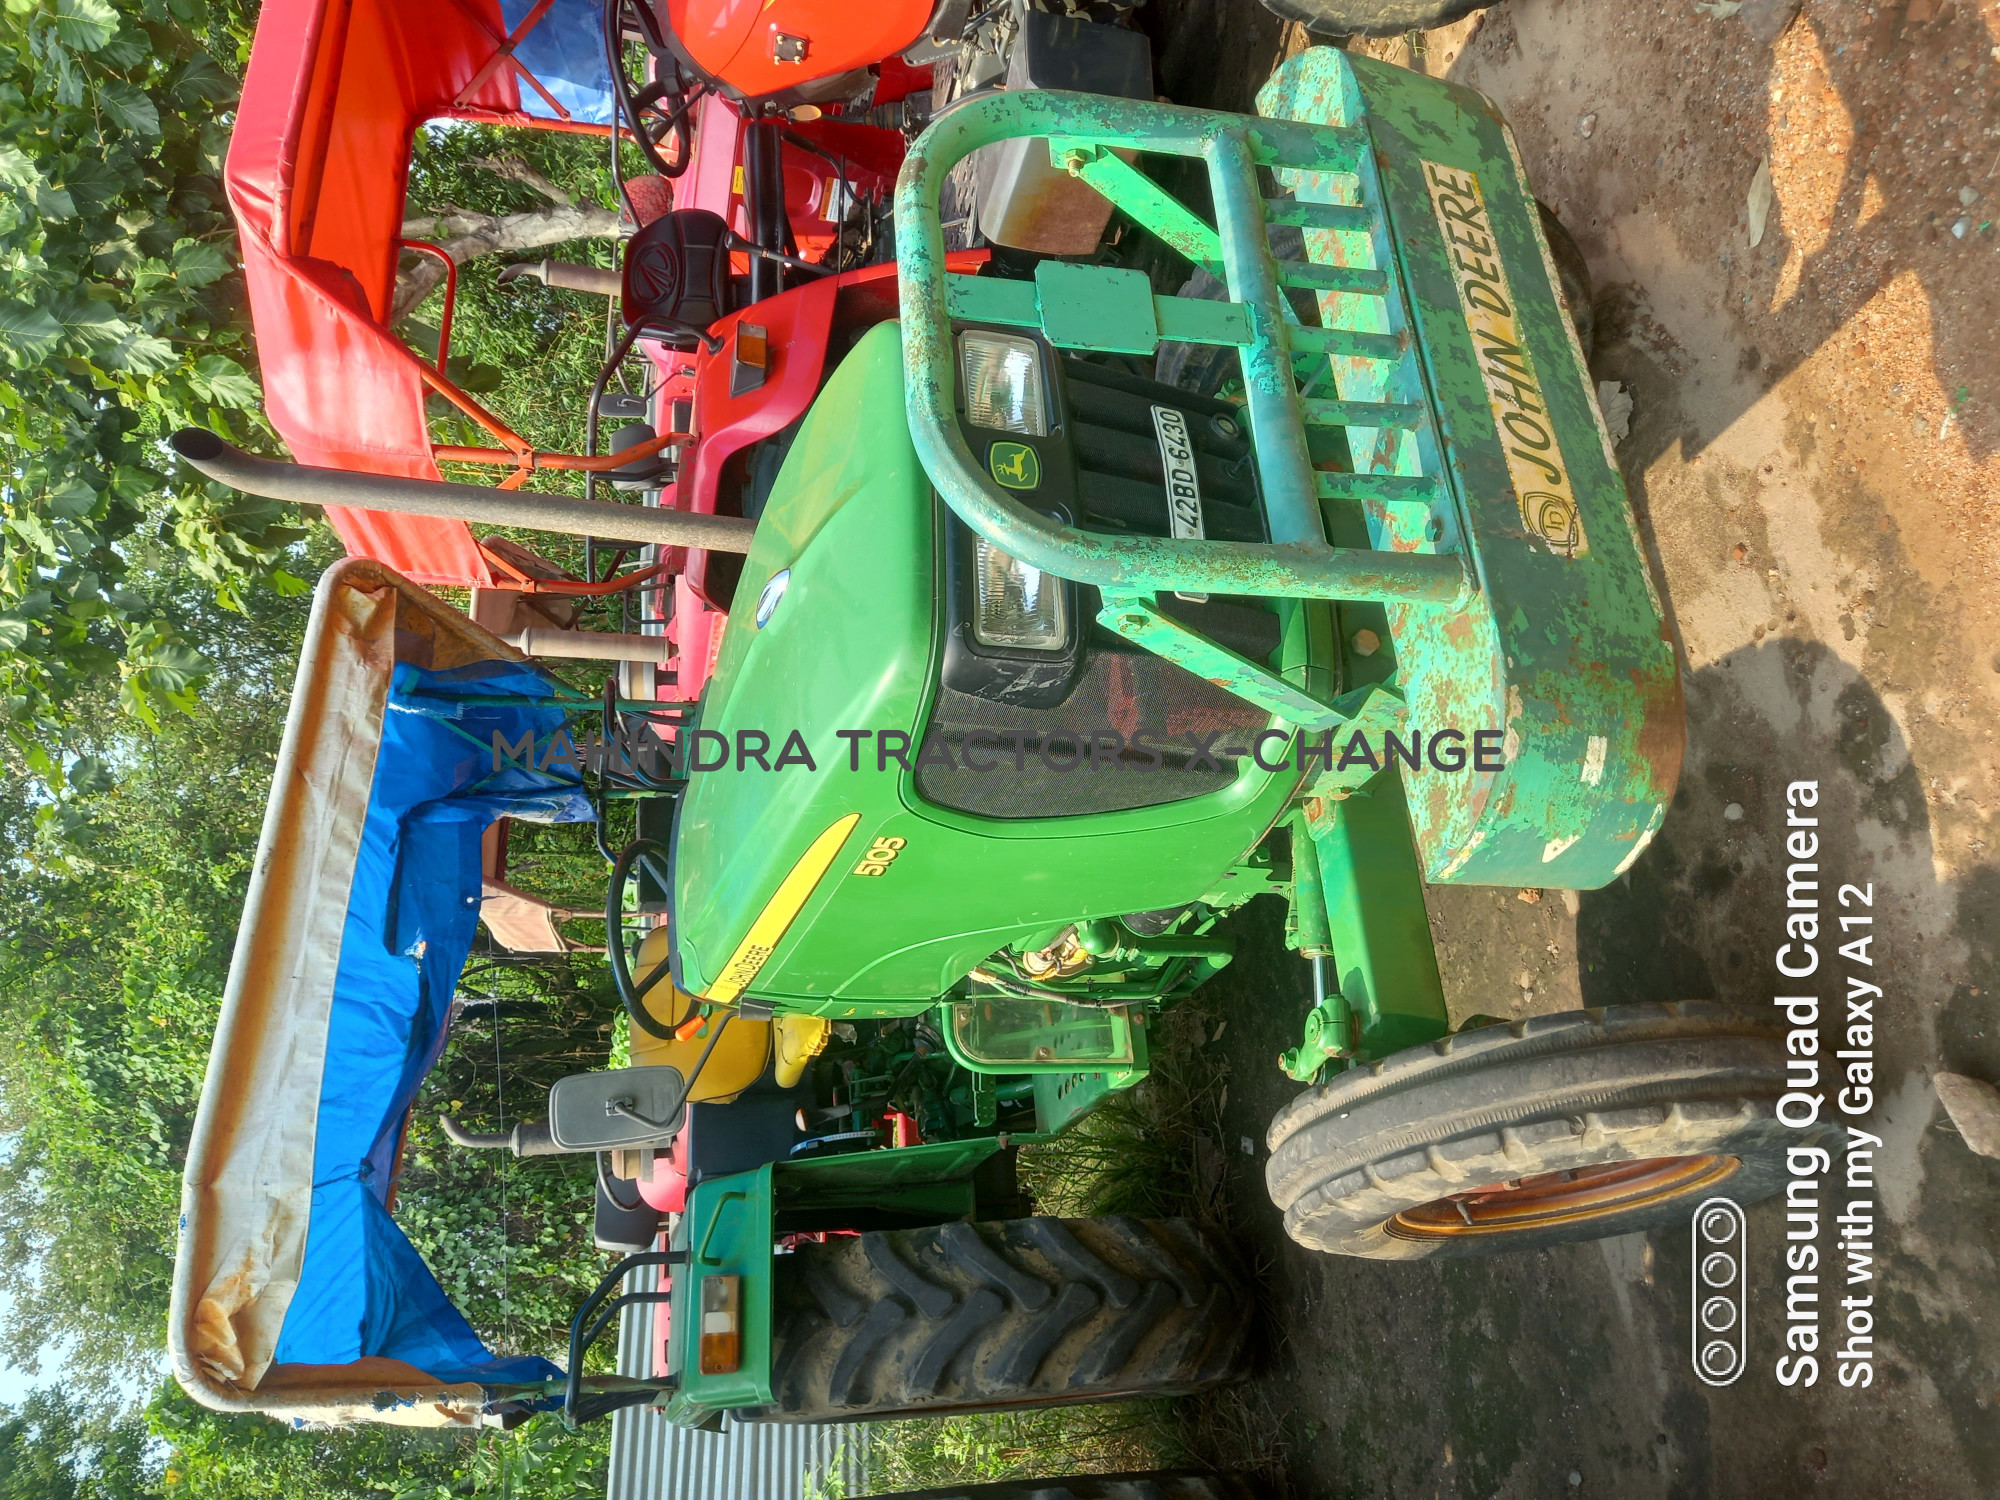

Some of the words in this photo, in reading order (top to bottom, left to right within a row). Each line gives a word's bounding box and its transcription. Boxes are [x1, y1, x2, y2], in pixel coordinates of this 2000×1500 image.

[1428, 164, 1511, 318] DEERE
[1159, 410, 1190, 461] 6430
[1475, 328, 1562, 485] JOHN
[1171, 468, 1199, 529] 42BD
[852, 836, 908, 877] 5105
